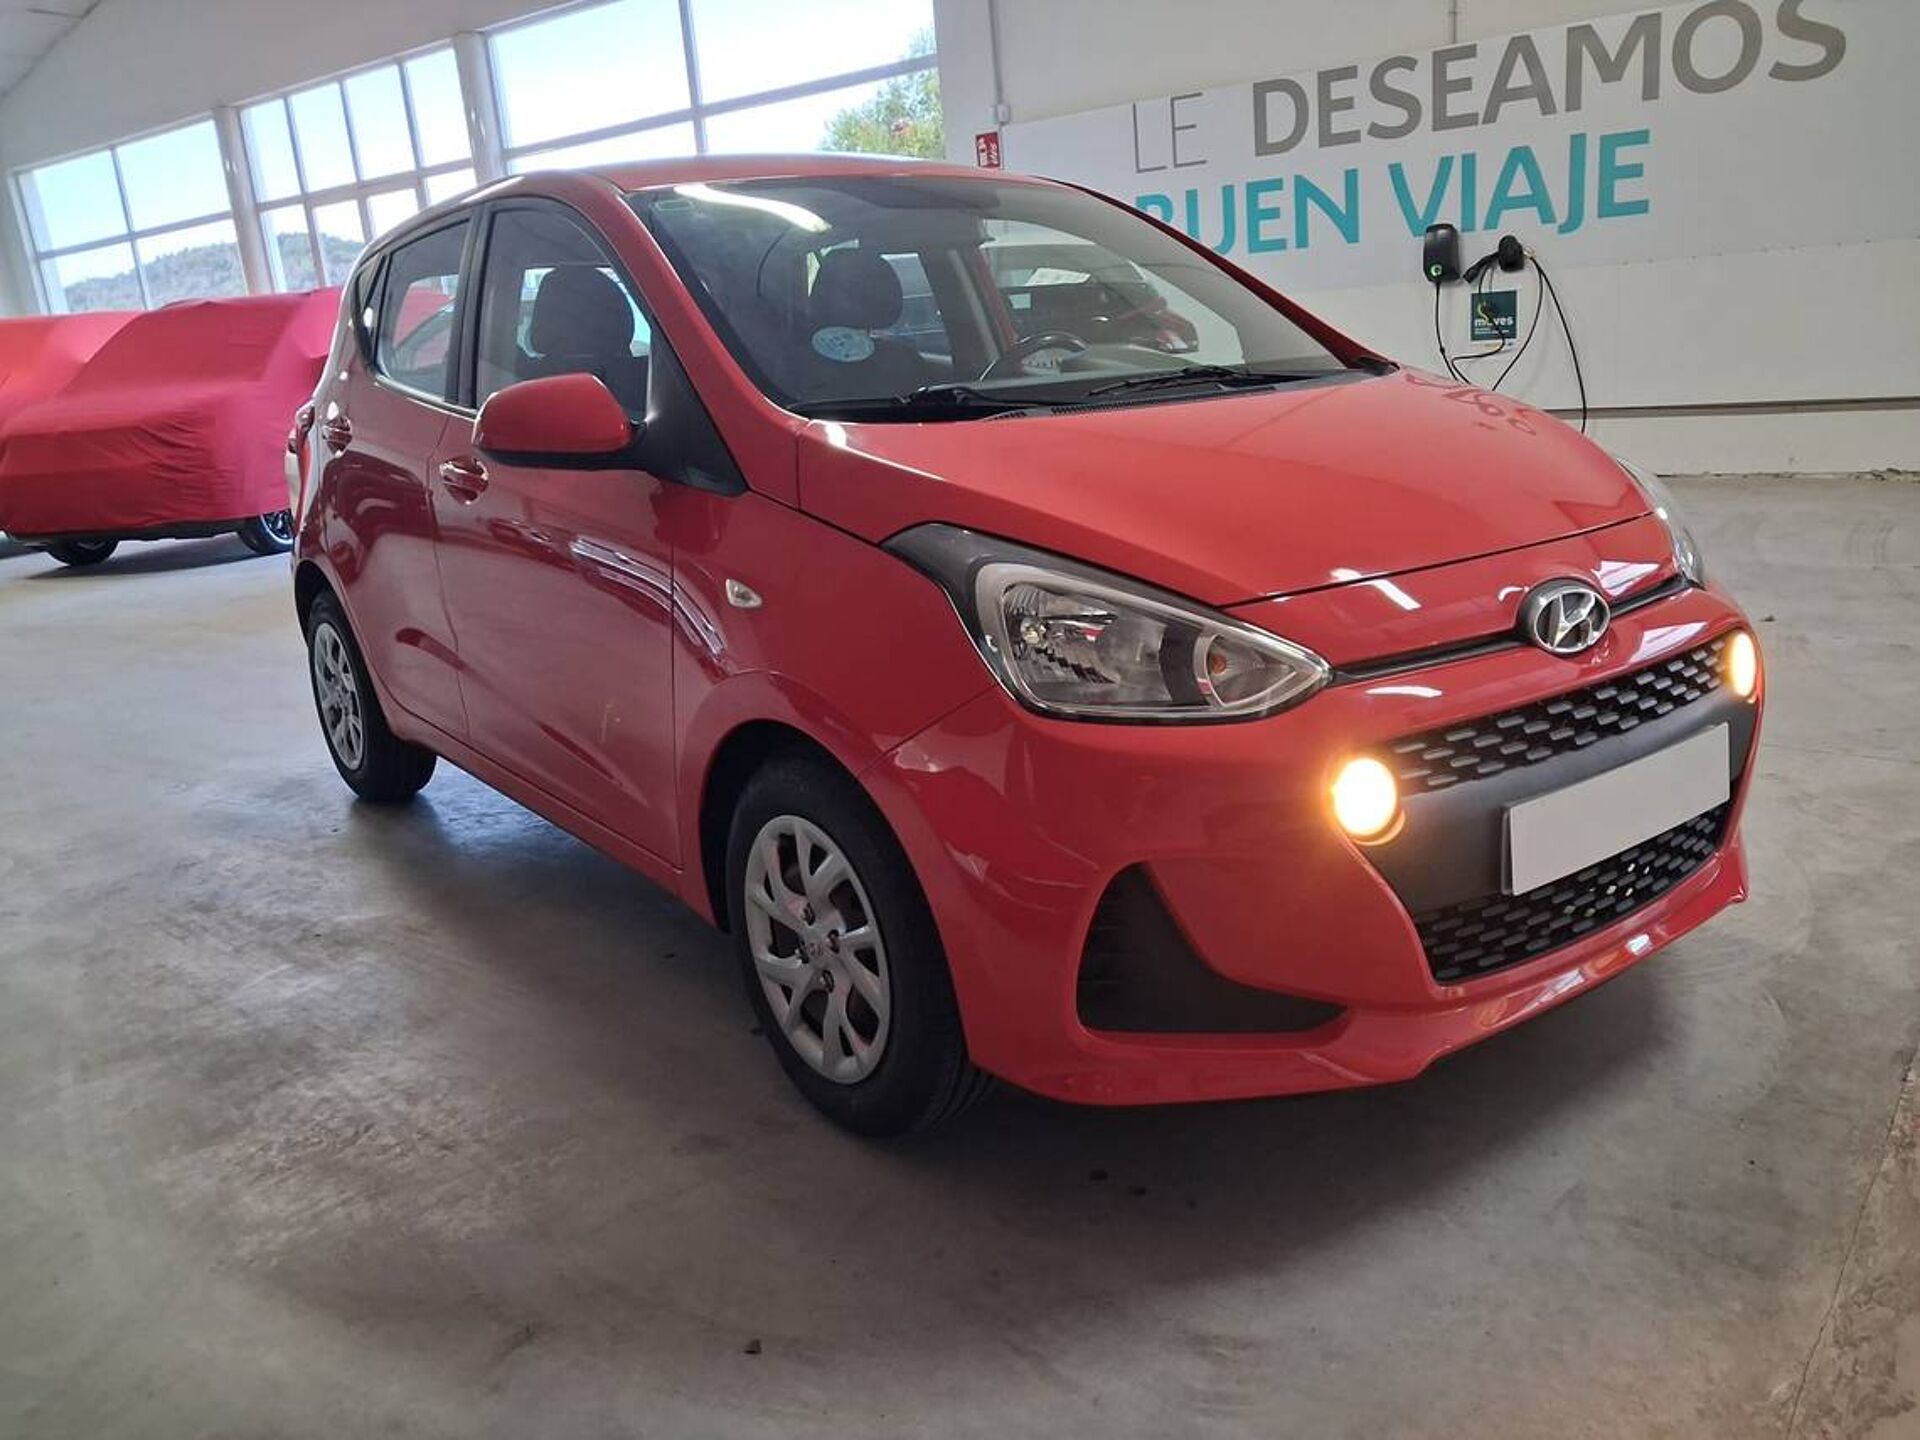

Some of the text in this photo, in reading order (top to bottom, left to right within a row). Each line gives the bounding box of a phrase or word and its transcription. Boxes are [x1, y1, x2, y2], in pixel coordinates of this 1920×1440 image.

[1133, 0, 1847, 174] LE DESEAMOS
[1387, 129, 1651, 239] VIAJE
[1474, 316, 1514, 328] mves
